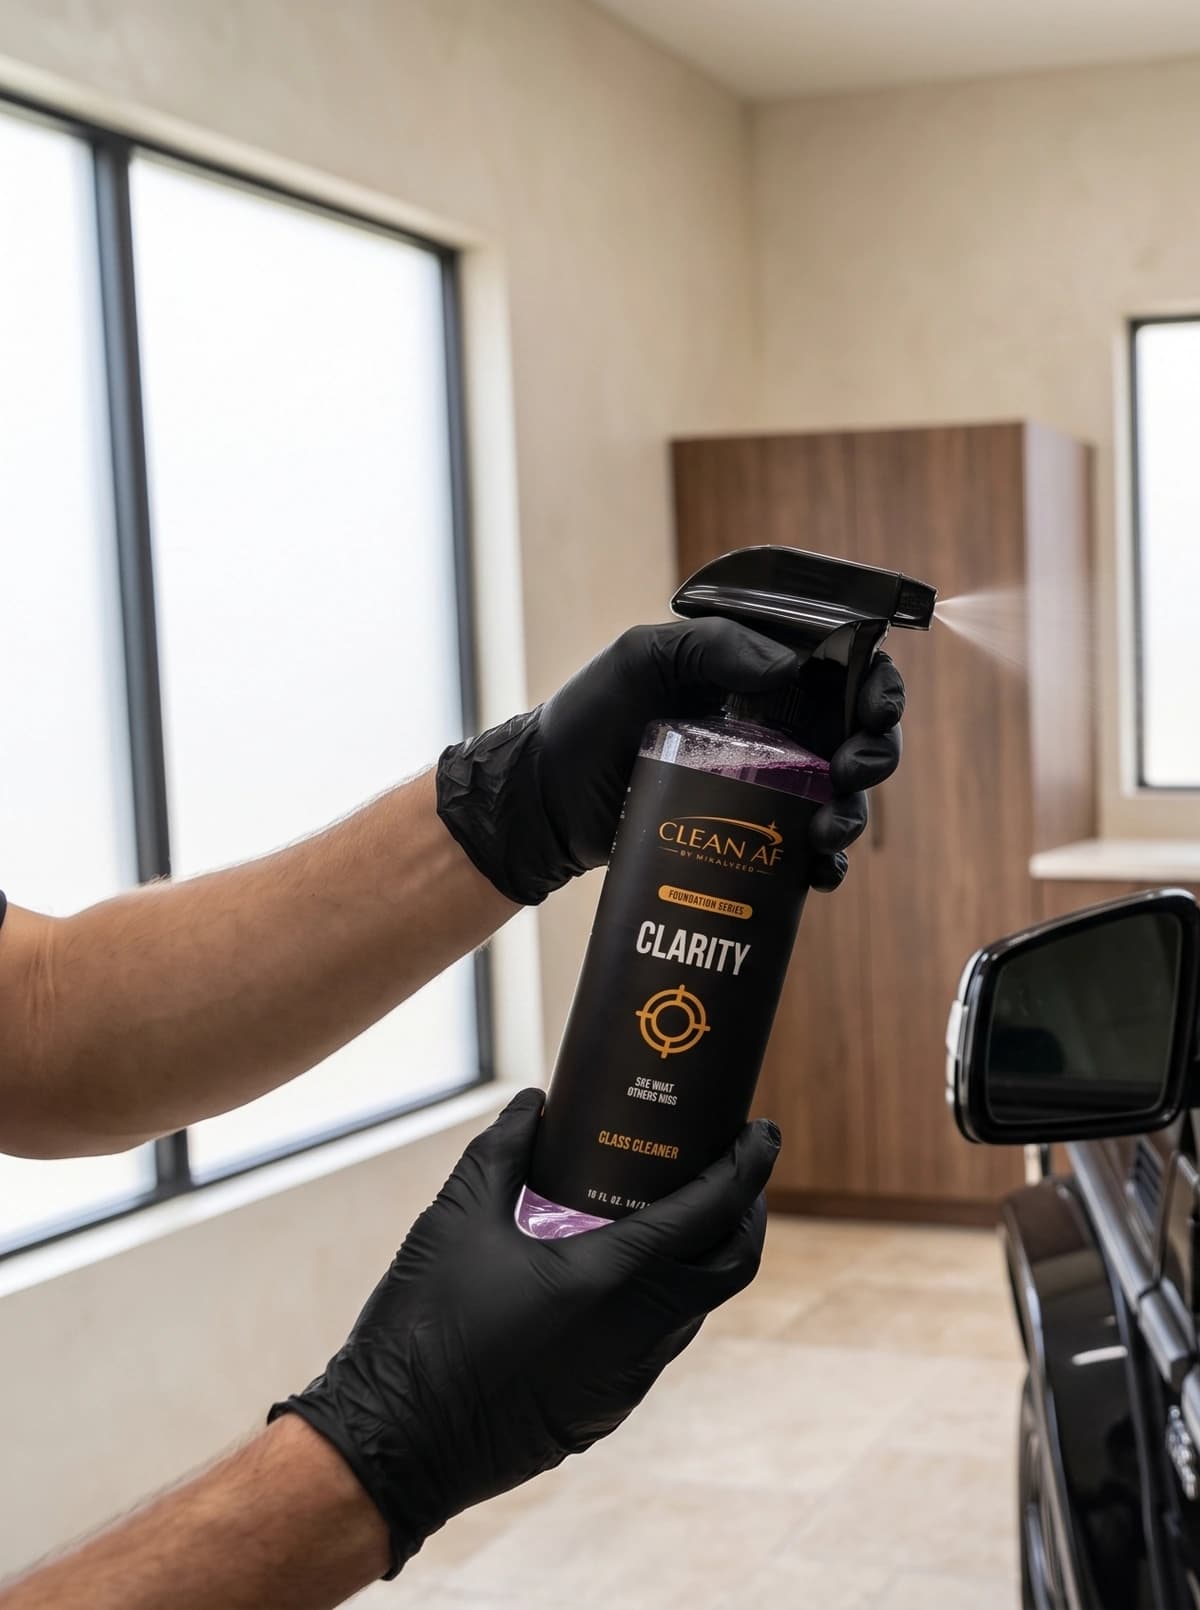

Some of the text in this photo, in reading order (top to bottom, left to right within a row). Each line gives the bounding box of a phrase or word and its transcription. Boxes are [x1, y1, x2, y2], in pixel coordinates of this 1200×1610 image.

[659, 821, 784, 866] CLEAN AF
[680, 849, 693, 858] BY
[668, 889, 745, 916] FOUNDATION SERIES
[636, 920, 752, 976] CLARITY
[627, 1086, 658, 1102] OTHERS
[598, 1130, 679, 1160] GLASS CLEANER
